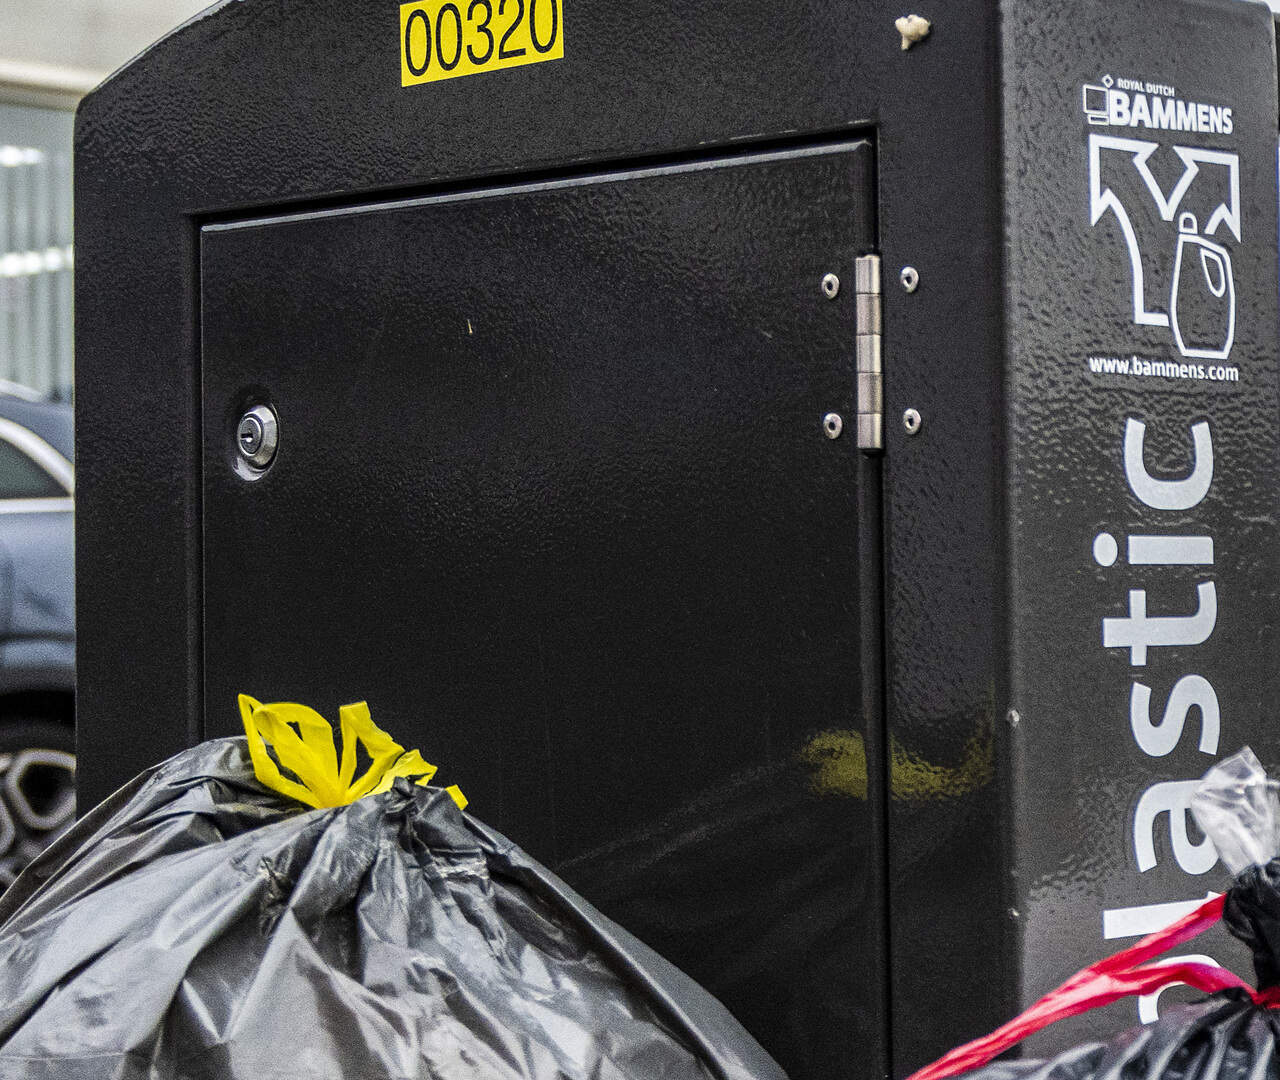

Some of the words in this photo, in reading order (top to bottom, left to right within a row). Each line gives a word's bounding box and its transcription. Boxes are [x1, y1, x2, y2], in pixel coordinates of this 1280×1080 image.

[405, 0, 558, 76] 00320
[1118, 78, 1144, 92] ROYAL
[1146, 83, 1175, 97] DUTCH
[1109, 88, 1233, 134] BAMMENS
[1089, 356, 1239, 381] www.bammens.com
